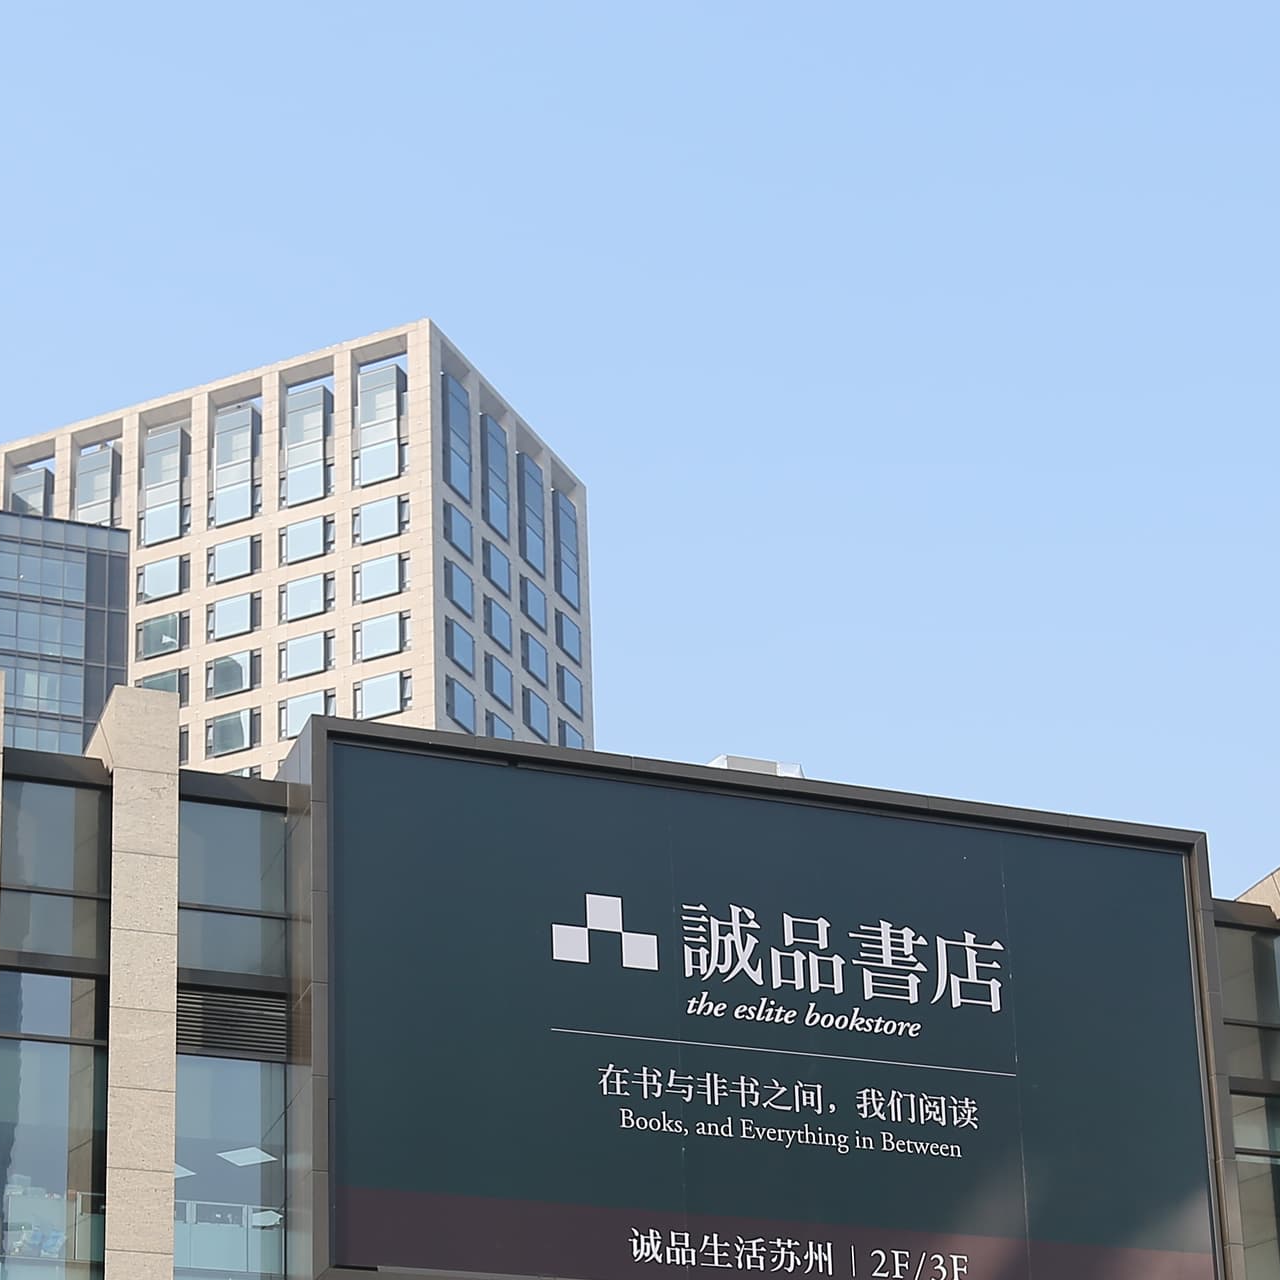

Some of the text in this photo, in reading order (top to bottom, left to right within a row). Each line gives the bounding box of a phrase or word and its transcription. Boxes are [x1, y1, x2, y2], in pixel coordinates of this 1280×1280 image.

[682, 904, 1004, 1013] 誠品書店
[687, 992, 922, 1037] the eslite bookstore
[620, 1109, 963, 1158] Books, and Everything in Between
[629, 1227, 834, 1276] 诚品生活苏州
